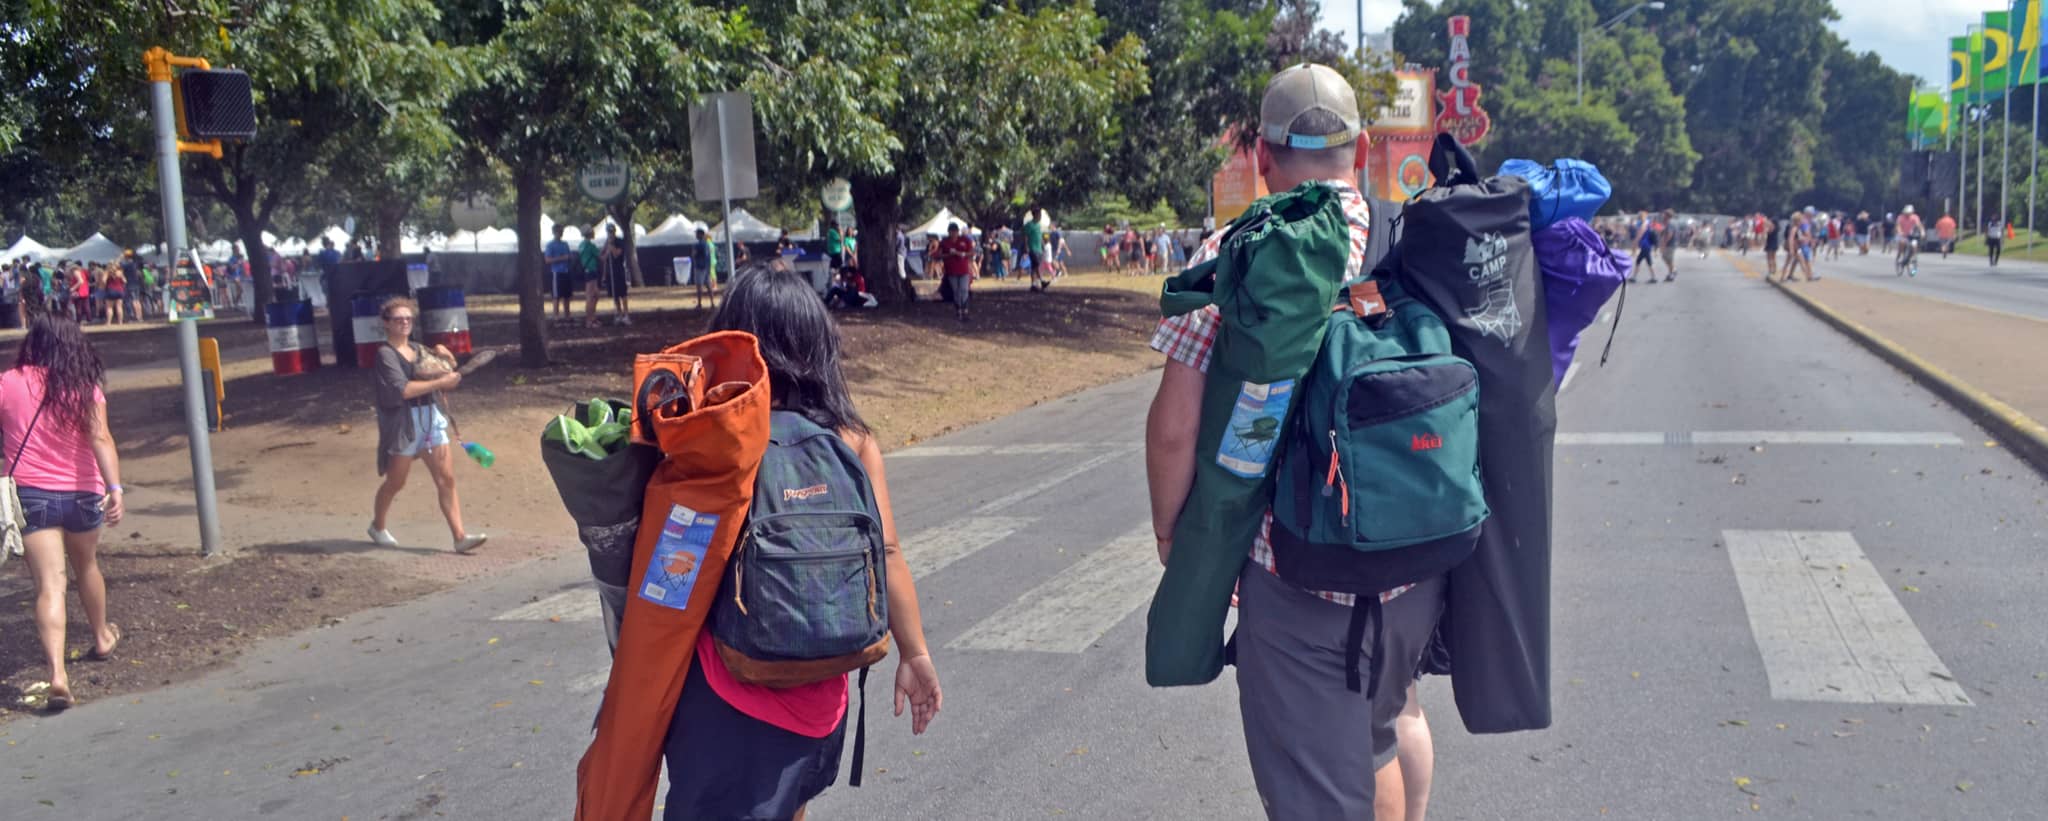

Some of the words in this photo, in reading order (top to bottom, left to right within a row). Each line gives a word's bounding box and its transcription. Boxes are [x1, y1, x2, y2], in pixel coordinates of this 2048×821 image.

[1449, 33, 1472, 115] ACL
[1441, 116, 1480, 129] MUSIC
[1469, 256, 1506, 280] CAMP
